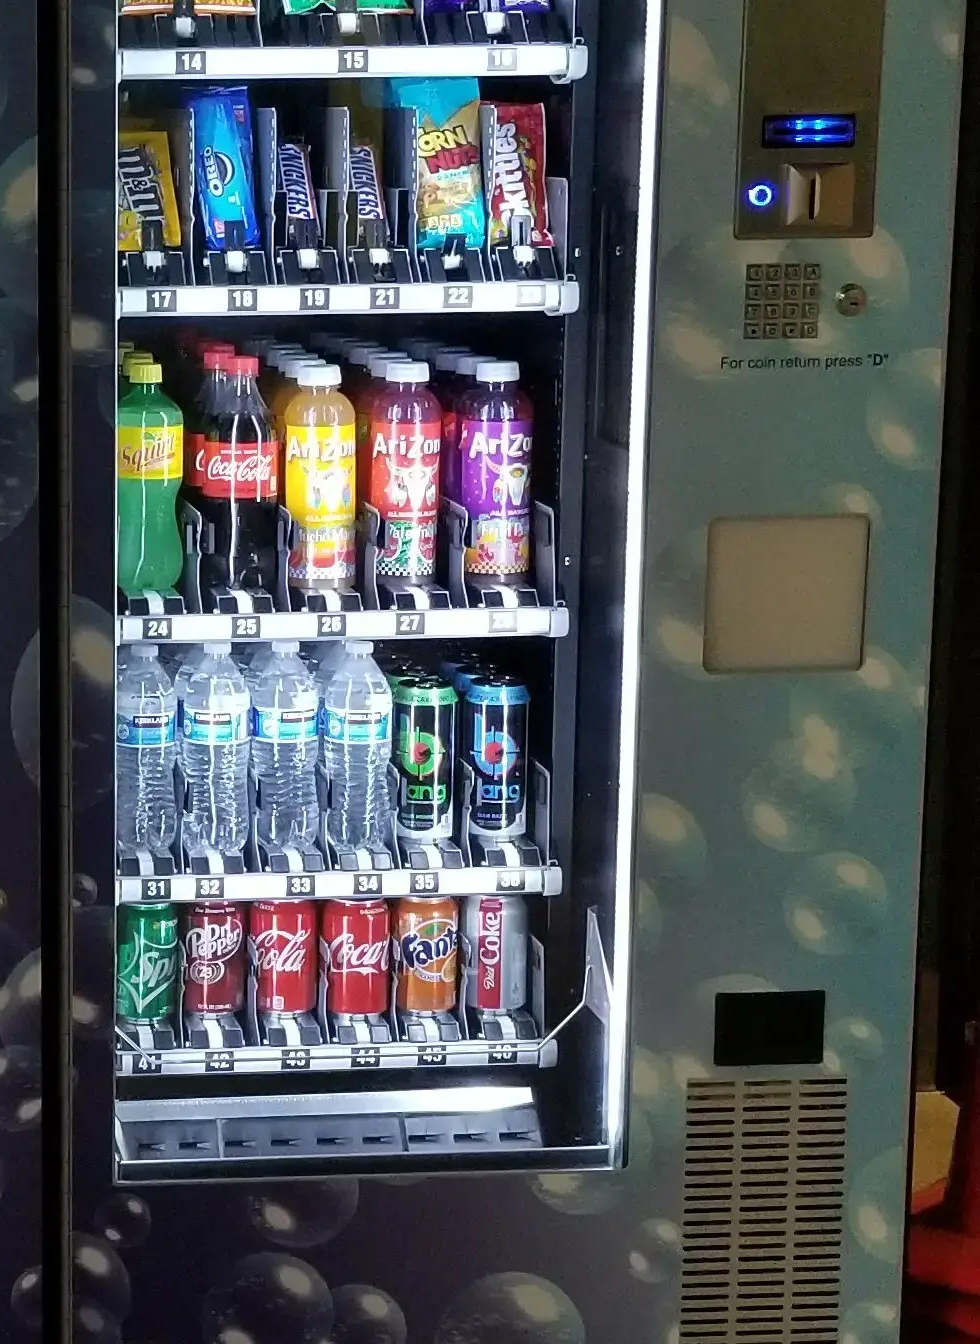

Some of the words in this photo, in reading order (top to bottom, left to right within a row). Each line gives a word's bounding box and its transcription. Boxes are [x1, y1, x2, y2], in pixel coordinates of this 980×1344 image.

[180, 52, 202, 70] 14
[342, 51, 364, 68] 15
[203, 146, 224, 198] OREO
[278, 143, 311, 220] SNICKERS
[349, 147, 383, 219] SNICKERS
[151, 291, 171, 308] 17
[232, 290, 254, 307] 18
[305, 289, 325, 306] 19
[375, 289, 395, 305] 21
[447, 288, 468, 303] 22
[720, 356, 745, 370] For
[748, 356, 776, 370] coin
[780, 356, 821, 370] return
[824, 356, 863, 371] press
[867, 353, 889, 367] "D"
[148, 621, 168, 636] 24
[236, 619, 256, 634] 25
[321, 617, 341, 632] 26
[399, 615, 420, 630] 27
[407, 784, 447, 804] ang
[481, 784, 520, 804] ang
[147, 882, 165, 896] 31
[200, 880, 220, 895] 32
[290, 878, 311, 893] 33
[358, 877, 377, 892] 34
[415, 875, 435, 890] 35
[207, 923, 232, 944] Dr
[479, 910, 503, 966] Coke
[189, 928, 240, 959] Pepper
[138, 1055, 157, 1070] 41
[209, 1053, 230, 1068] 42
[356, 1049, 376, 1064] 44
